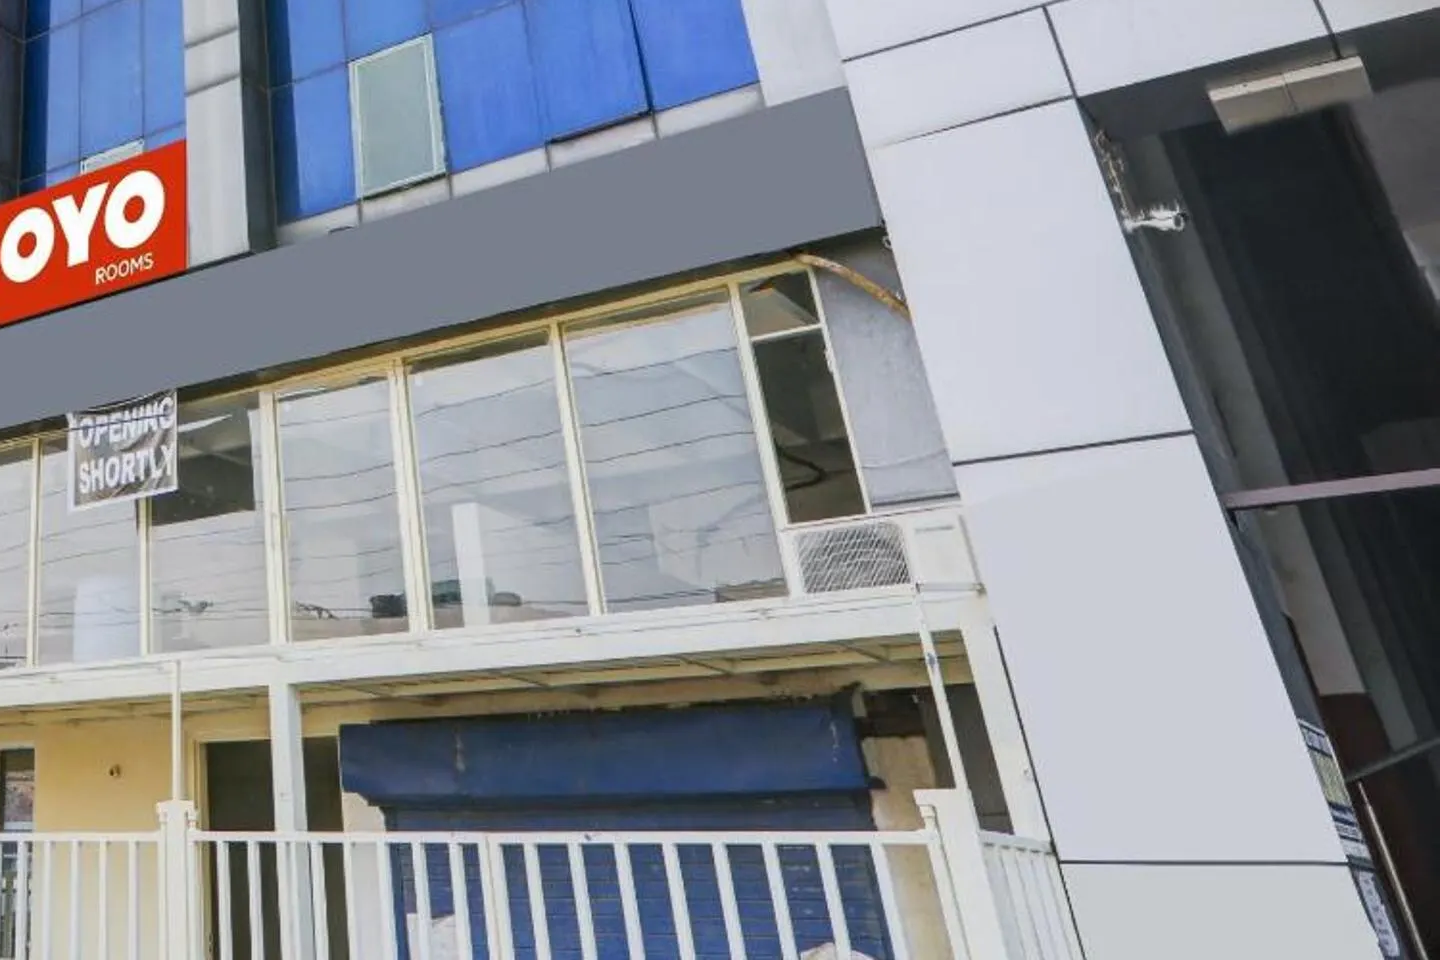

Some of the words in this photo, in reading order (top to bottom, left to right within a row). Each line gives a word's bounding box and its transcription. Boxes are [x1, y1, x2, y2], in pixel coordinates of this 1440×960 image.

[0, 170, 165, 283] OYO
[95, 253, 154, 285] ROOMS
[79, 397, 174, 448] OPENING
[79, 444, 174, 494] SHORTLY
